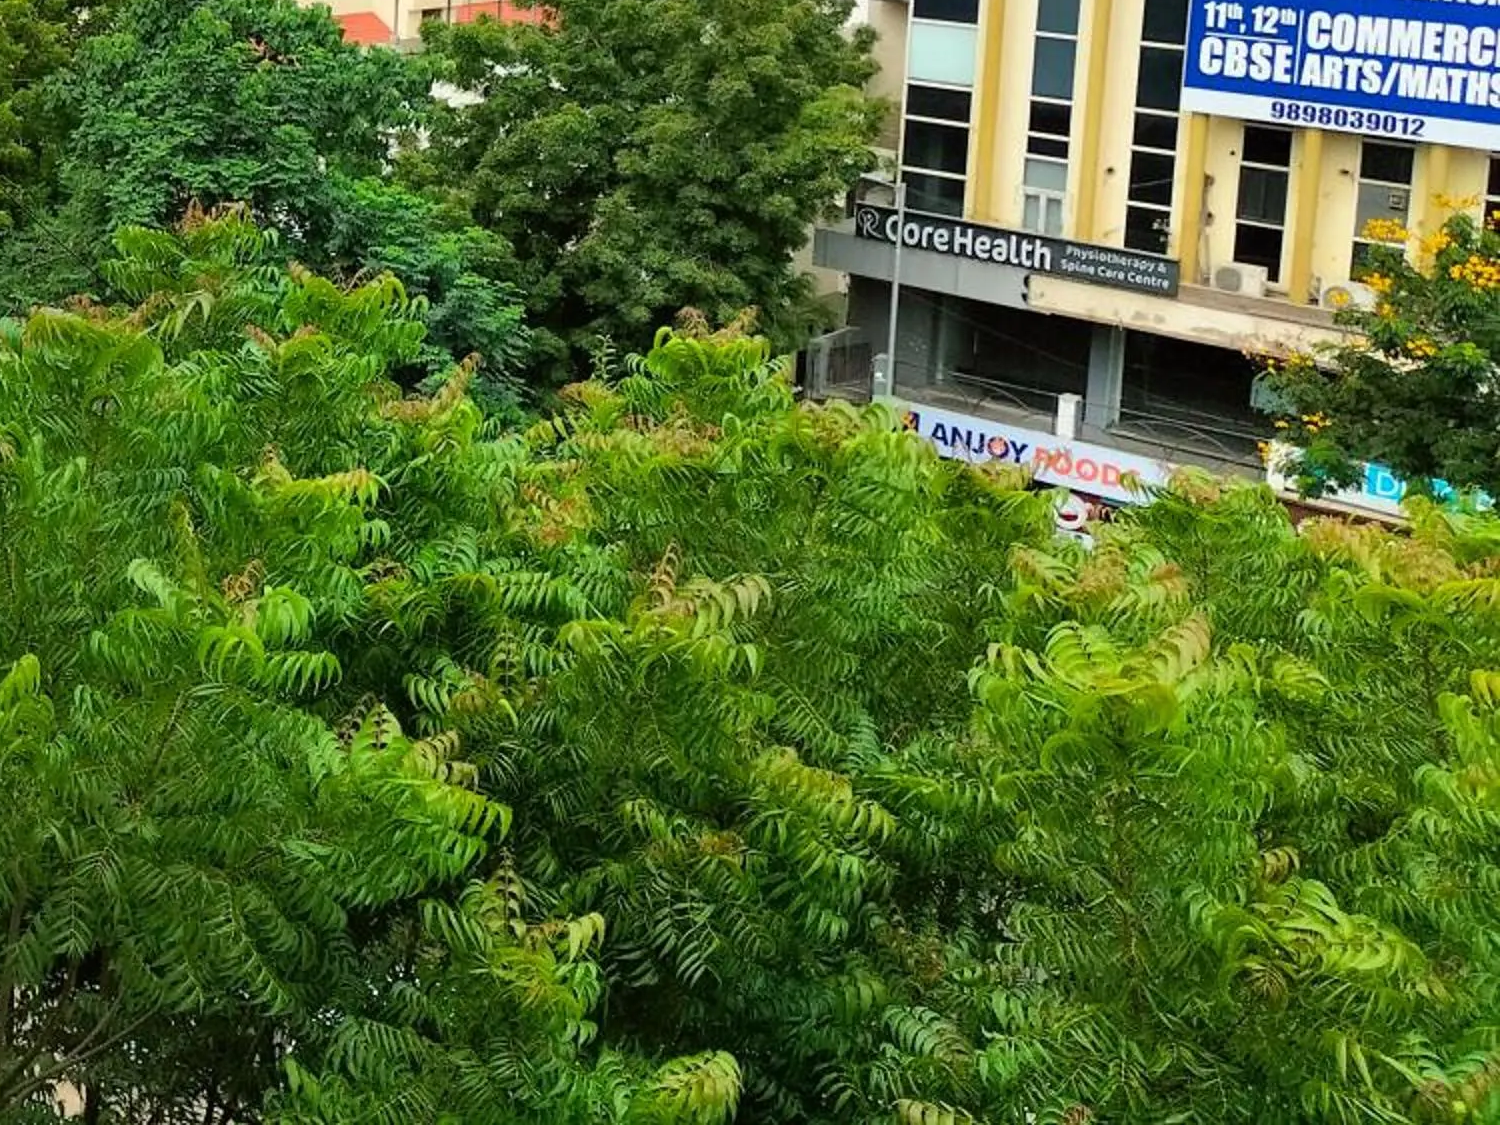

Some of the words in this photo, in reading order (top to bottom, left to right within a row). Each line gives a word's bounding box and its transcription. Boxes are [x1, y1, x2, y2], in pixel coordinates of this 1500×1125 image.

[1252, 5, 1297, 35] 12th
[1307, 10, 1500, 68] COMMERC
[1199, 36, 1293, 84] CBSE
[1270, 101, 1427, 137] 9898039012
[1060, 258, 1095, 275] Spine
[1098, 266, 1125, 281] Care
[1128, 271, 1170, 289] Centre
[1065, 245, 1155, 272] Physiotherapy
[1158, 262, 1167, 273] &
